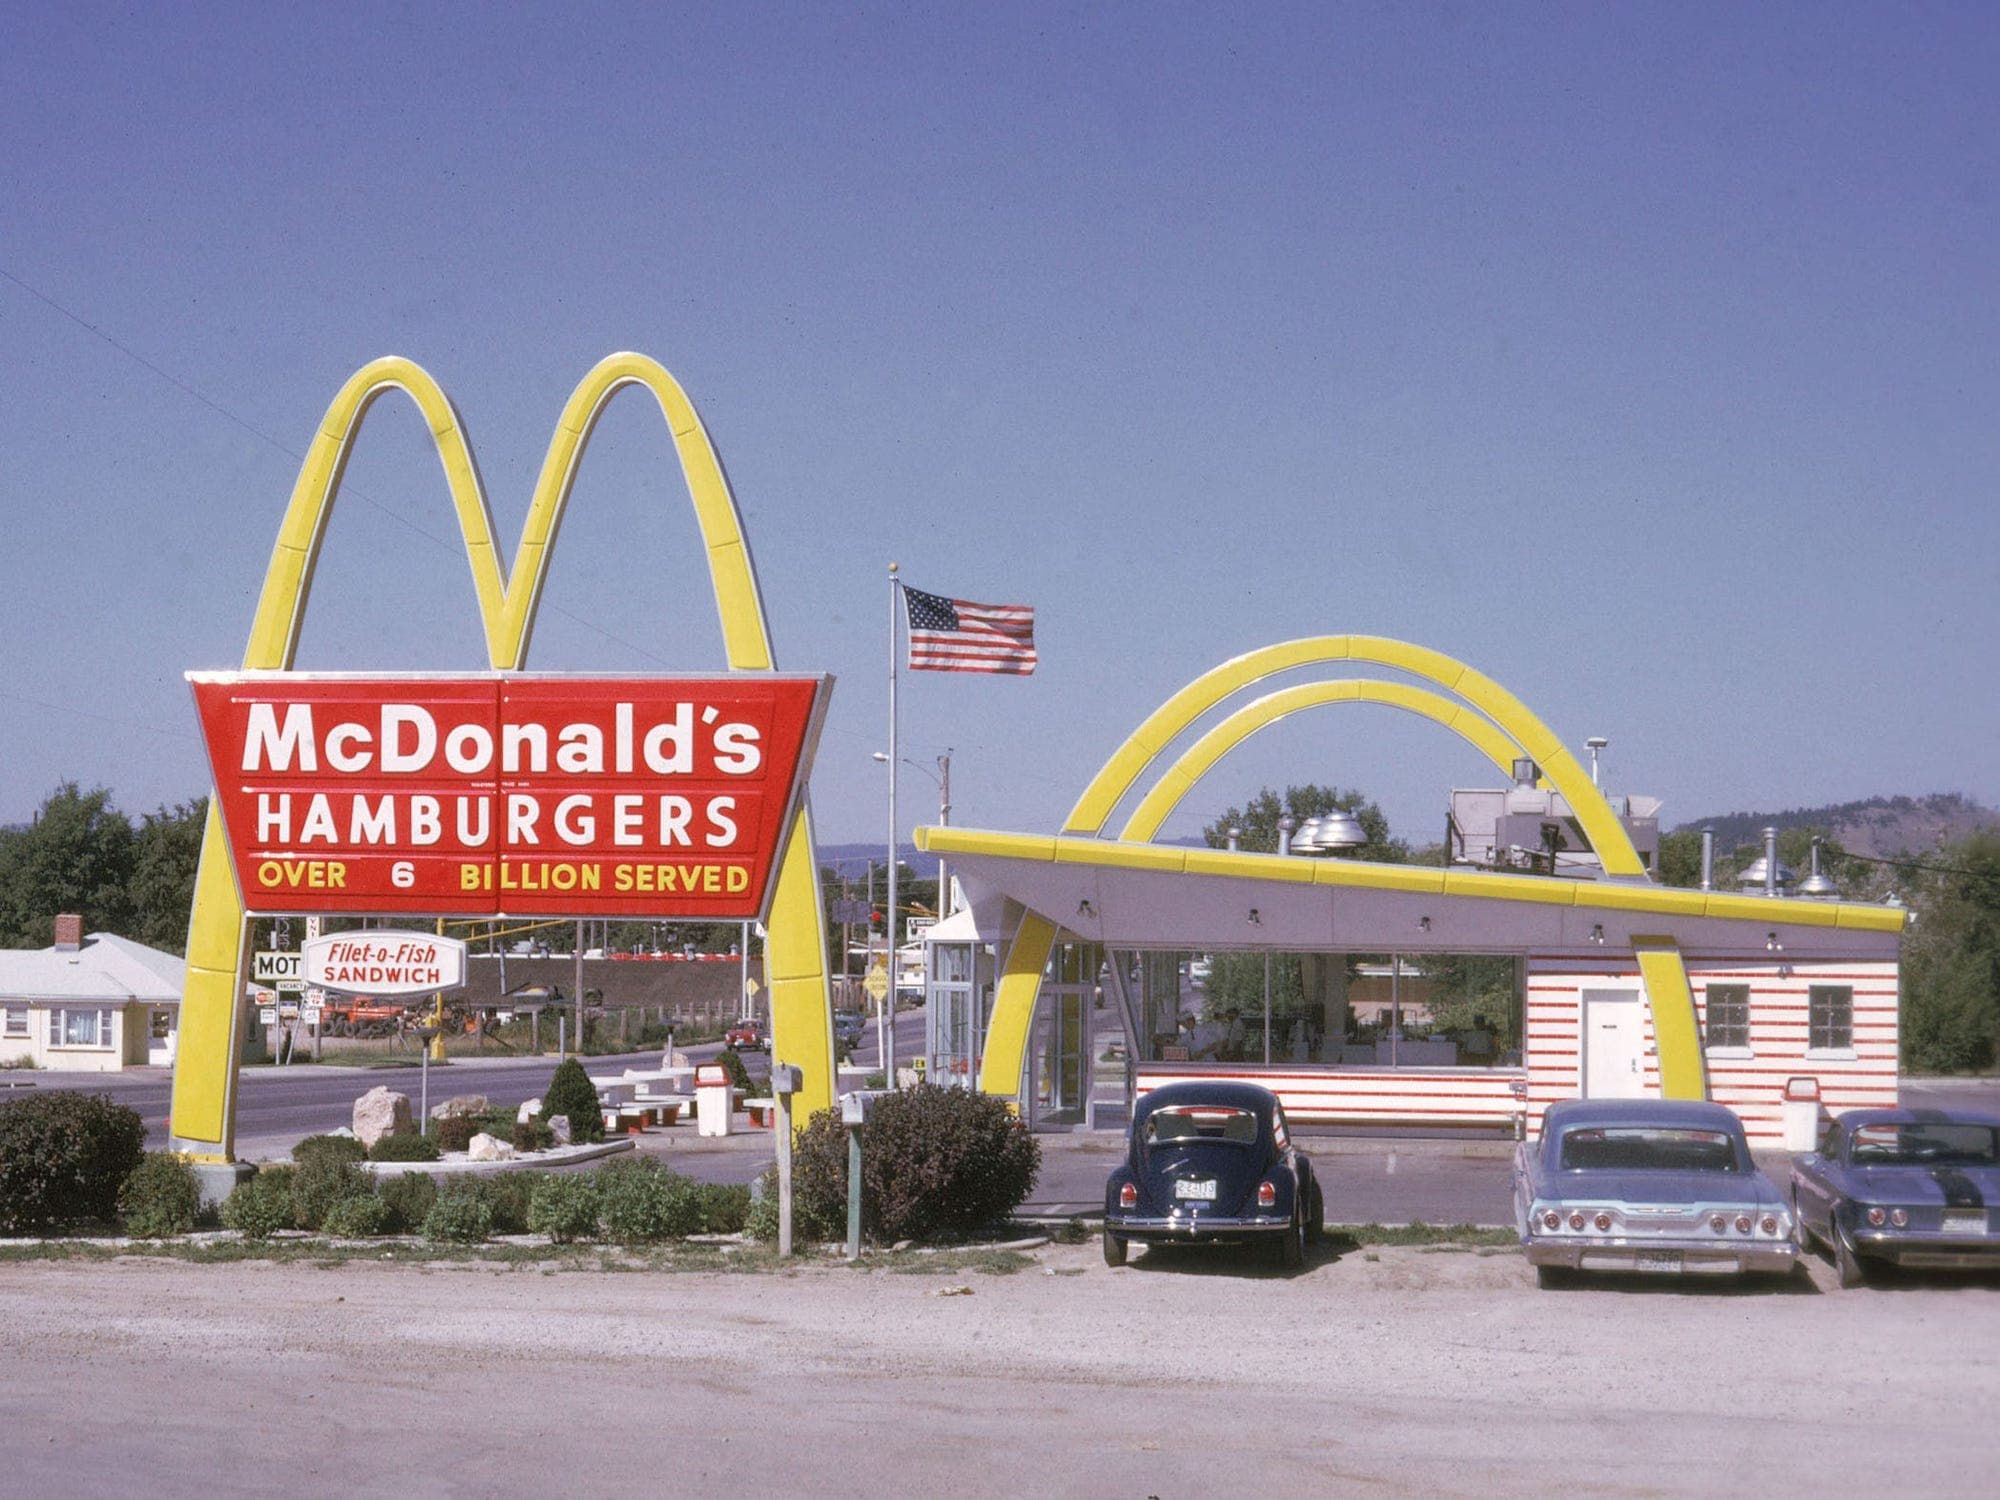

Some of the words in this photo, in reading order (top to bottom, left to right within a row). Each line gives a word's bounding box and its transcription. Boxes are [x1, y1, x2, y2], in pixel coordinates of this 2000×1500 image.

[242, 702, 762, 775] McDonald's
[257, 793, 738, 848] HAMBURGERS
[257, 861, 347, 888] OVER
[391, 861, 416, 888] 6
[460, 863, 601, 891] BILLION
[614, 864, 749, 893] SERVED
[327, 943, 437, 964] Filet-o-Fish
[324, 966, 440, 984] SANDWICH
